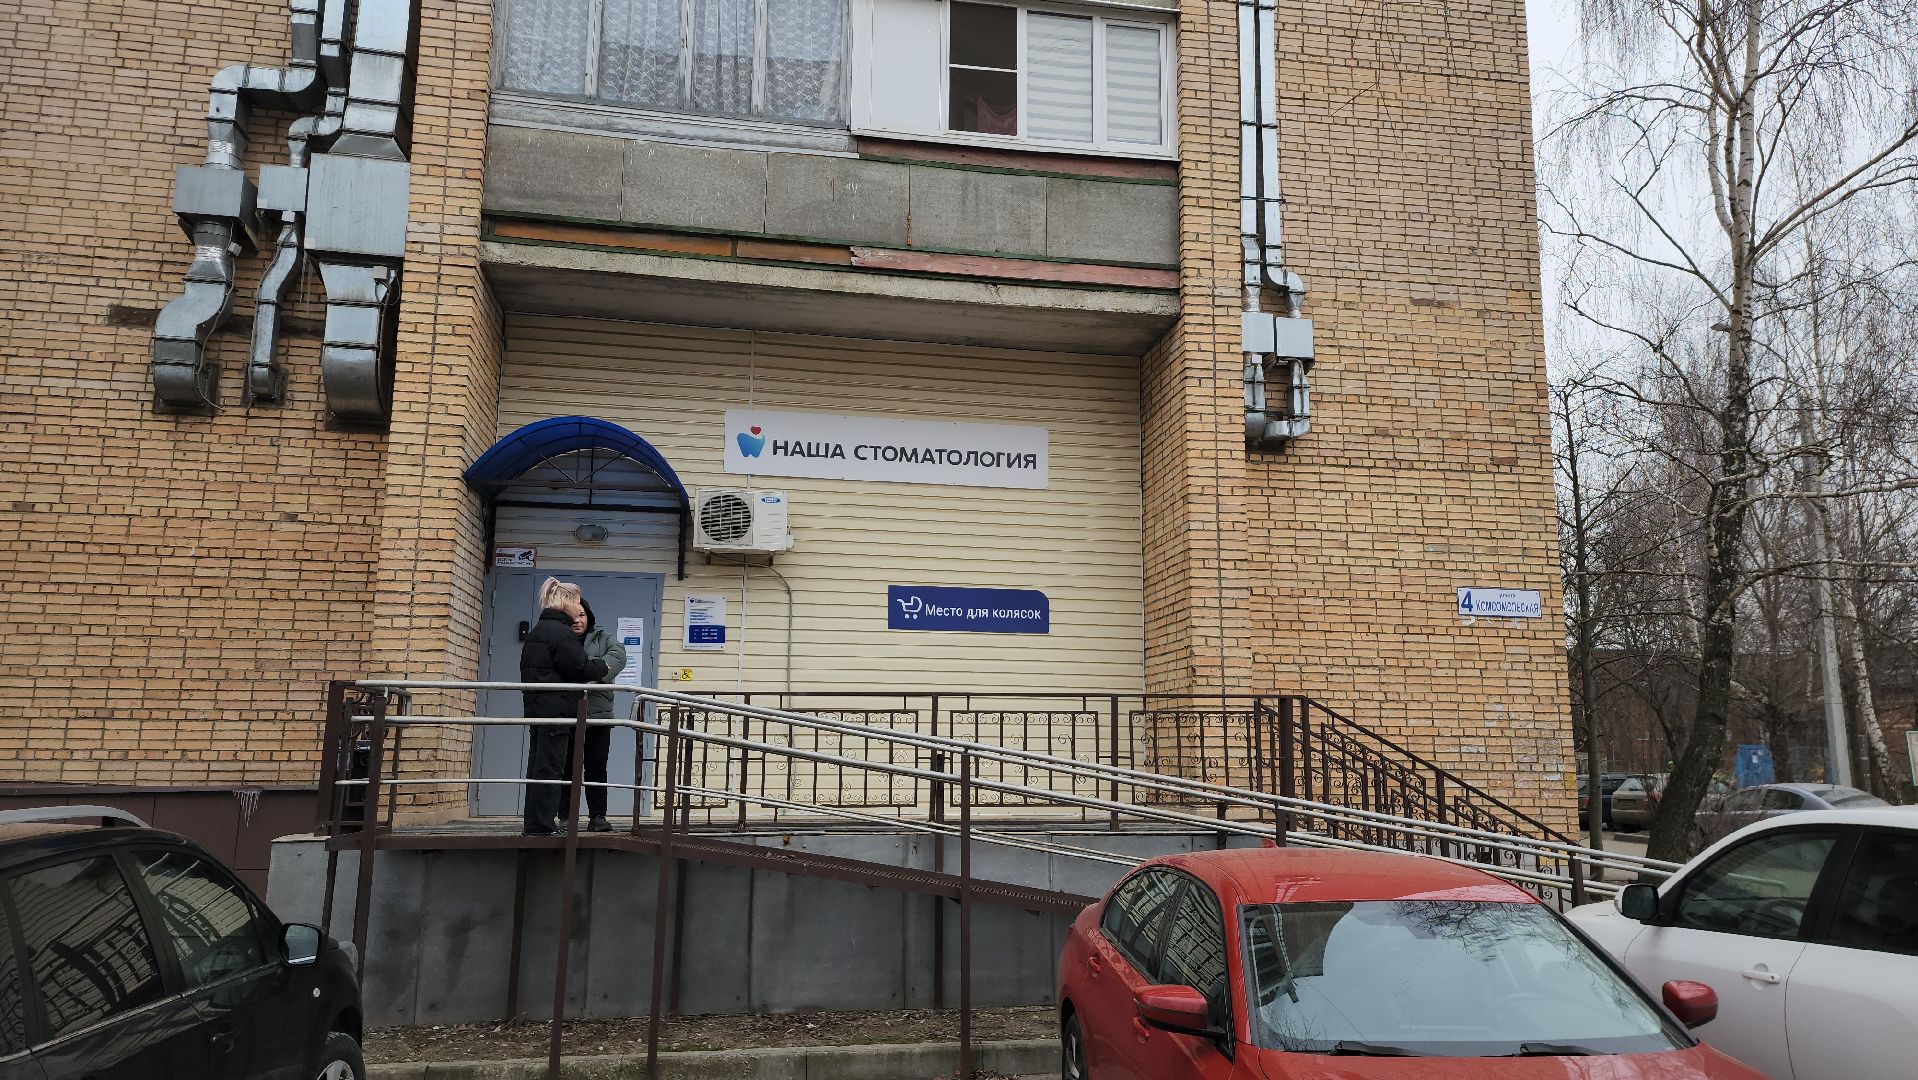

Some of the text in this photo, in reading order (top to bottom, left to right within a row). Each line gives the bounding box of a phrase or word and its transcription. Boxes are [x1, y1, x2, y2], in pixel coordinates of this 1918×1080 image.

[773, 440, 1037, 469] НАША СТОМАТОЛОГИЯ
[925, 603, 1041, 620] Место для колясок
[1461, 590, 1473, 613] 4
